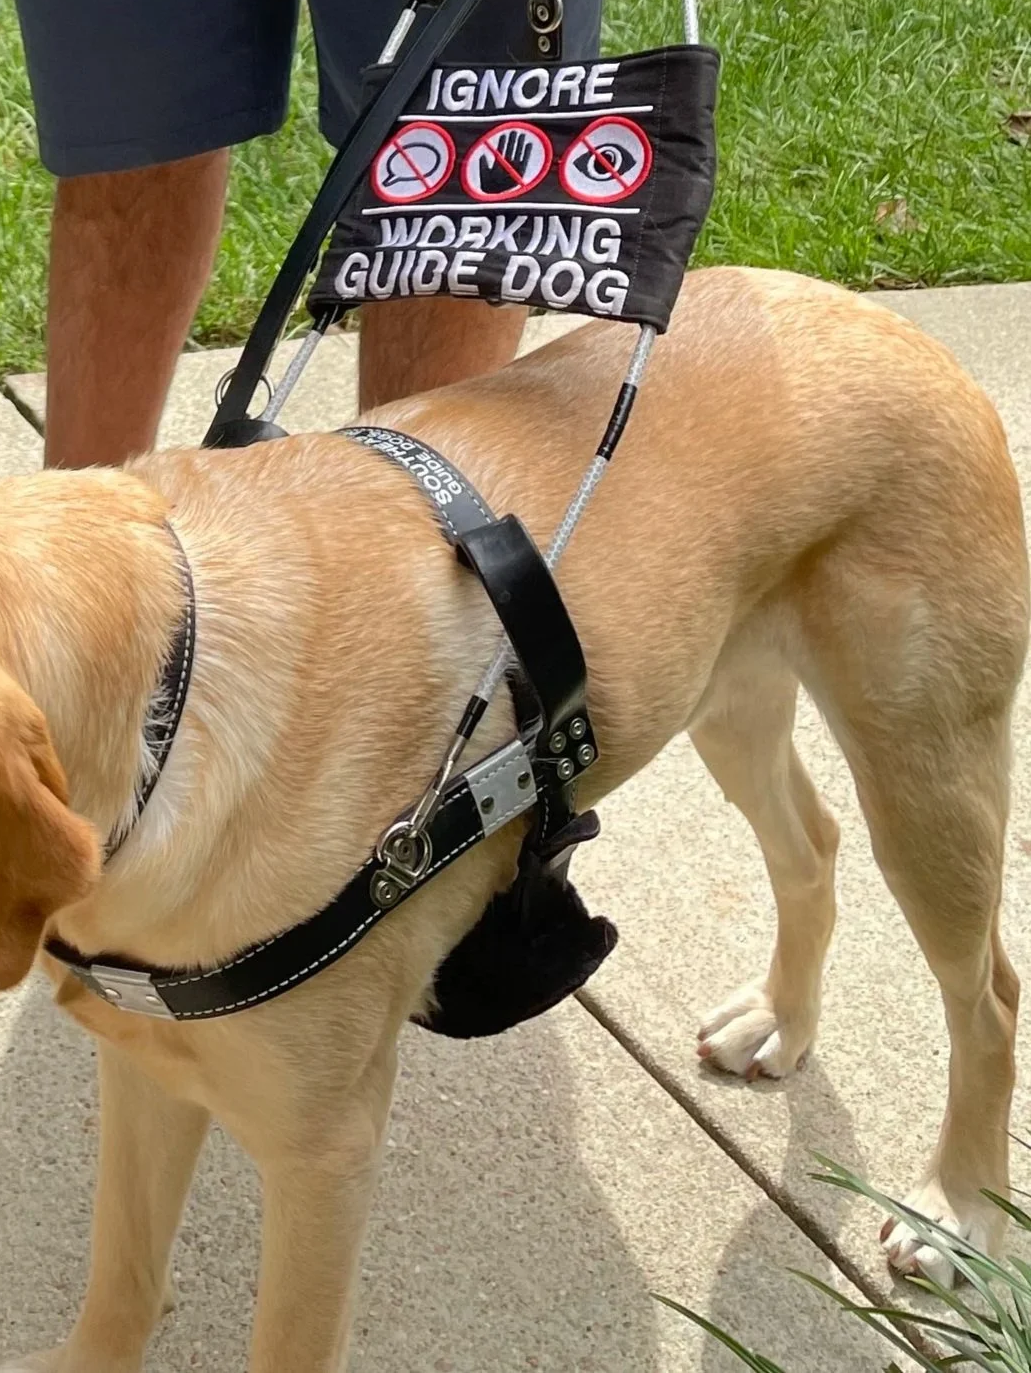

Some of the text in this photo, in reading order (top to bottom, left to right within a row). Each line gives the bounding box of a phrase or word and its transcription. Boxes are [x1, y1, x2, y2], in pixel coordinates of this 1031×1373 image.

[427, 63, 621, 111] IGNORE
[378, 215, 622, 263] WORKING
[334, 250, 630, 315] GUIDE DOG
[416, 452, 462, 494] GUIDE
